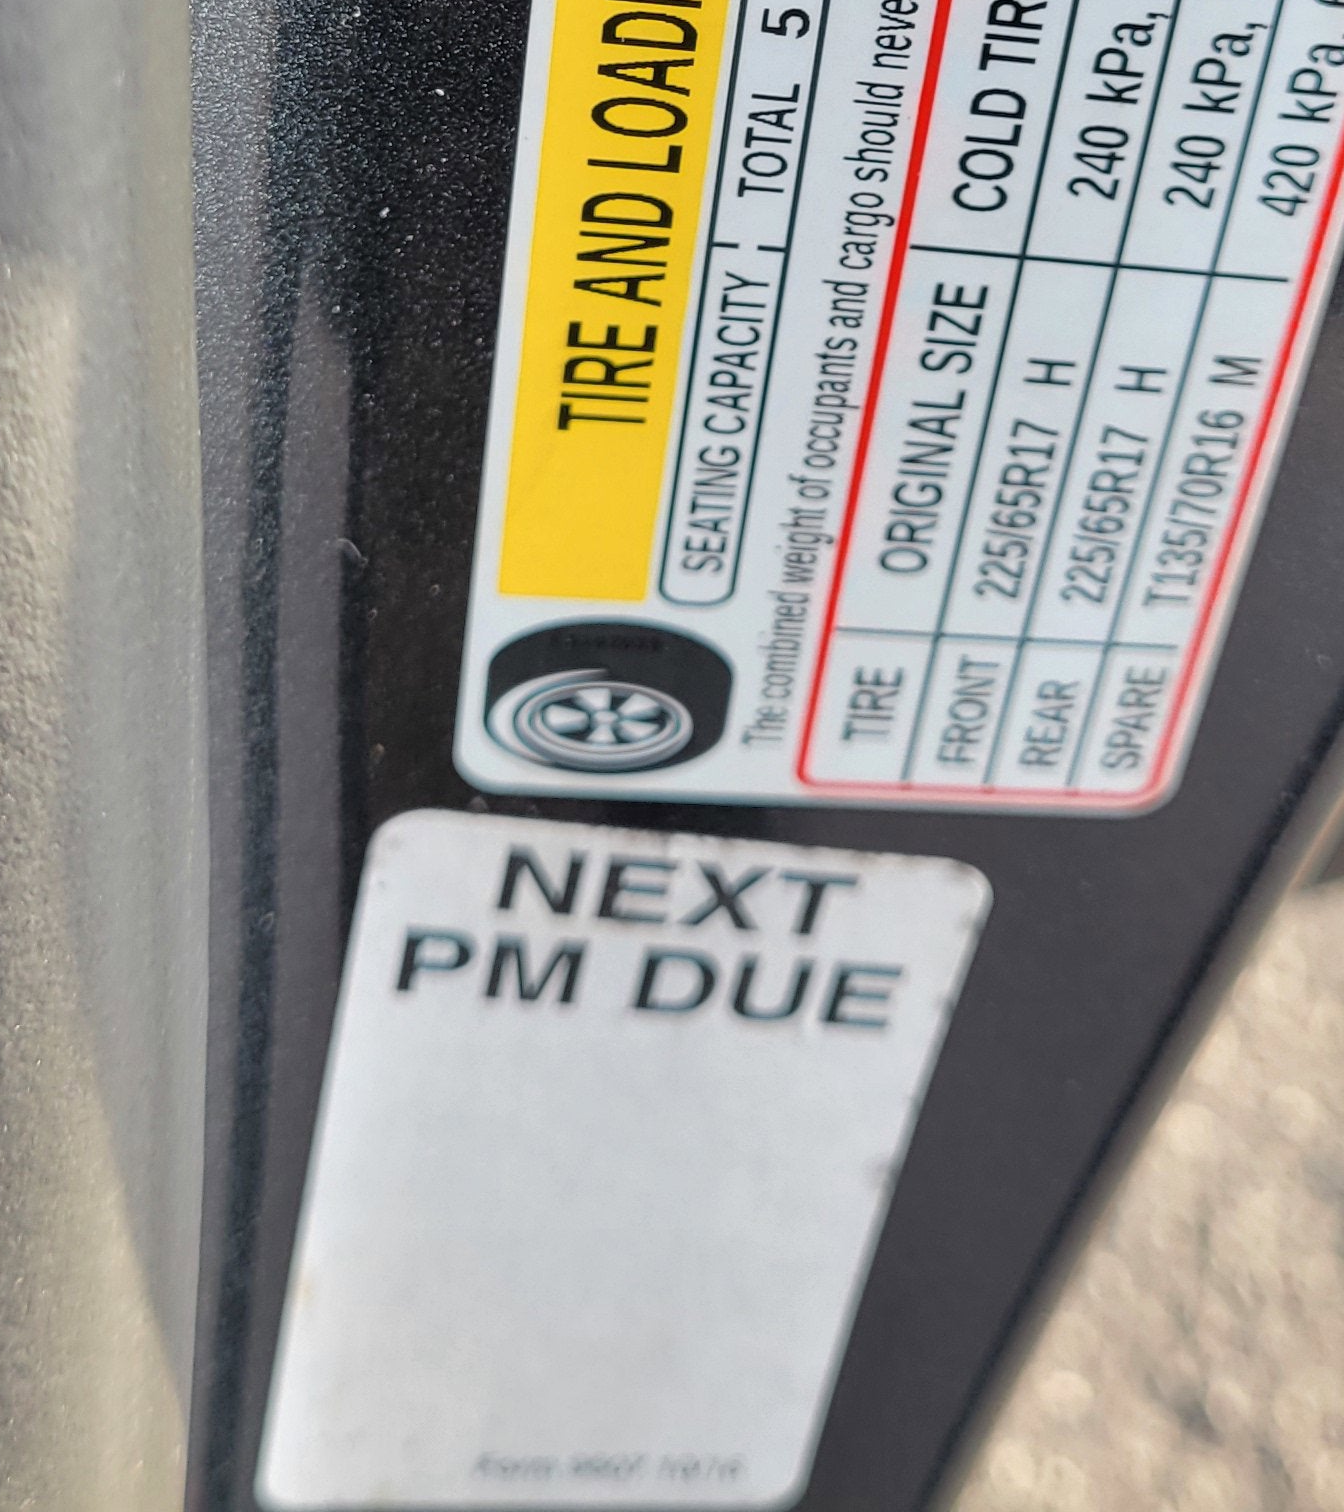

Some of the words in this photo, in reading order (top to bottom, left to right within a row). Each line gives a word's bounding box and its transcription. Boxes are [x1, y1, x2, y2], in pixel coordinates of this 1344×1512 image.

[761, 7, 811, 38] 5
[1085, 12, 1173, 105] kPa,
[1183, 23, 1273, 114] kPa,
[739, 84, 801, 198] TOTAL
[844, 82, 904, 182] should
[952, 88, 1027, 213] COLD
[1068, 125, 1130, 200] 240
[1163, 135, 1227, 210] 240
[573, 193, 674, 307] AND
[840, 193, 895, 271] cargo
[822, 279, 868, 328] and
[919, 283, 989, 375] SIZE
[557, 322, 658, 431] TIRE
[704, 271, 770, 435] CAPACITY
[1023, 357, 1077, 387] H
[1115, 365, 1168, 395] H
[803, 335, 861, 469] occupants
[789, 474, 830, 499] of
[879, 391, 967, 575] ORIGINAL
[1101, 665, 1167, 771] SPARE
[1144, 409, 1244, 610] T135/70R16
[1207, 354, 1264, 387] M
[1259, 145, 1321, 217] 420
[683, 445, 740, 575] SEATING
[775, 508, 834, 584] weight
[974, 420, 1063, 600] 225/65R17
[1061, 426, 1150, 606] 225/65R17
[757, 590, 811, 699] combined
[741, 705, 788, 745] The
[843, 666, 904, 742] TIRE
[937, 655, 1000, 767] FRONT
[1019, 679, 1080, 767] REAR
[497, 843, 859, 936] NEXT
[394, 927, 589, 1006] PM
[632, 946, 905, 1030] DUE
